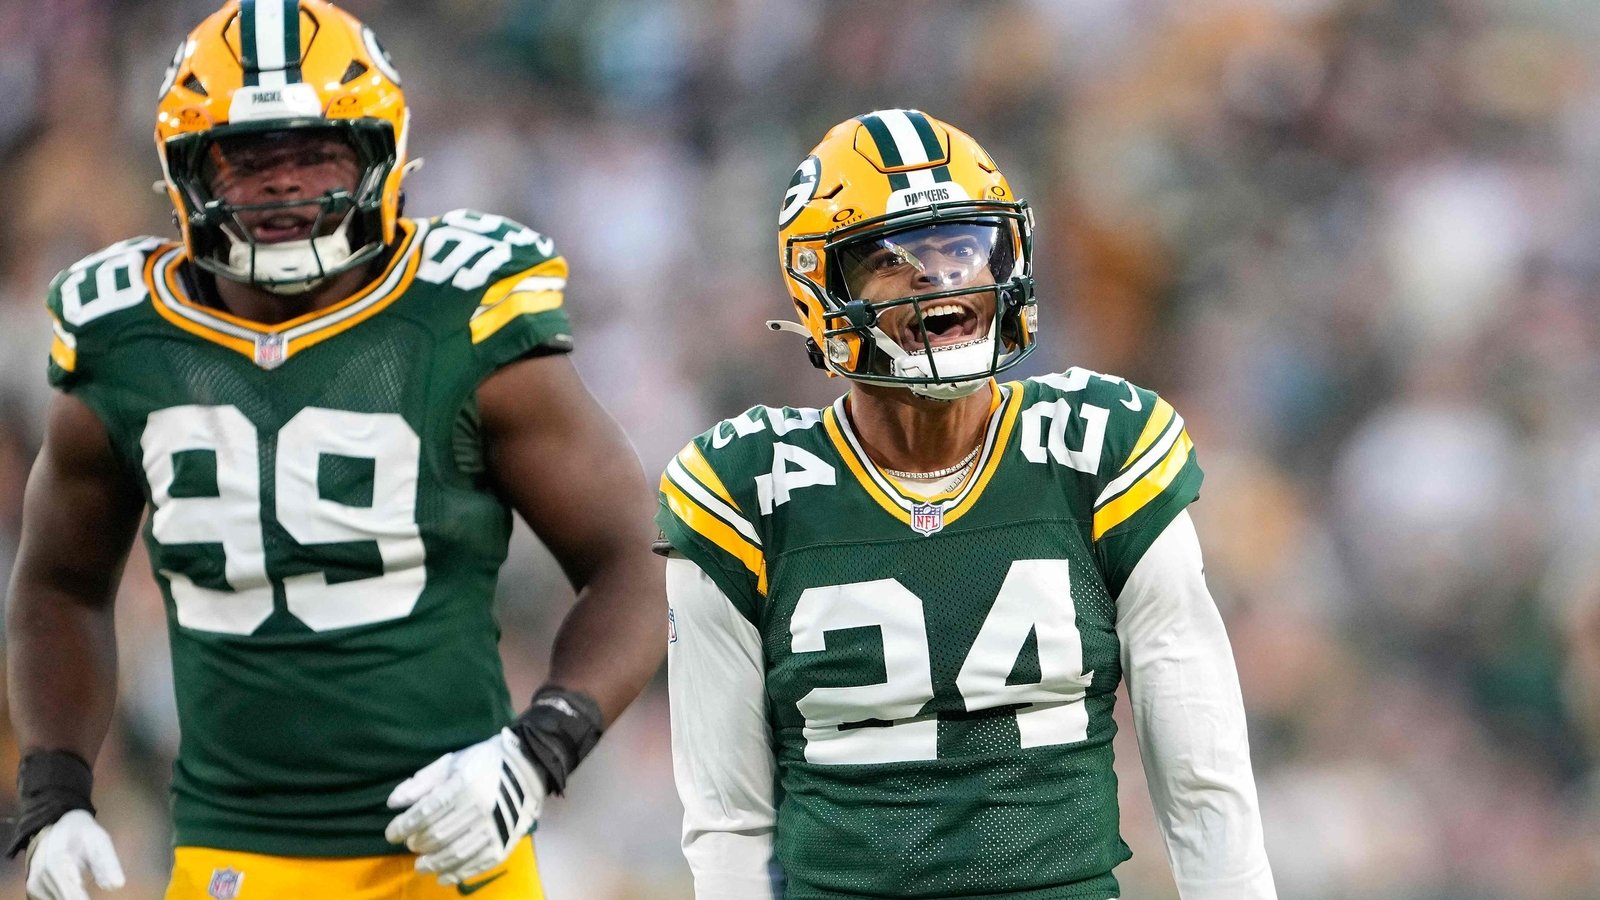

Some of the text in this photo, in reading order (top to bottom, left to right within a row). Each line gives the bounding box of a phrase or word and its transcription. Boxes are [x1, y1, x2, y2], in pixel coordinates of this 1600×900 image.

[252, 90, 284, 104] PACKE
[904, 188, 950, 207] PACKERS
[140, 404, 428, 636] 99
[916, 515, 938, 530] NFL
[790, 559, 1094, 764] 24
